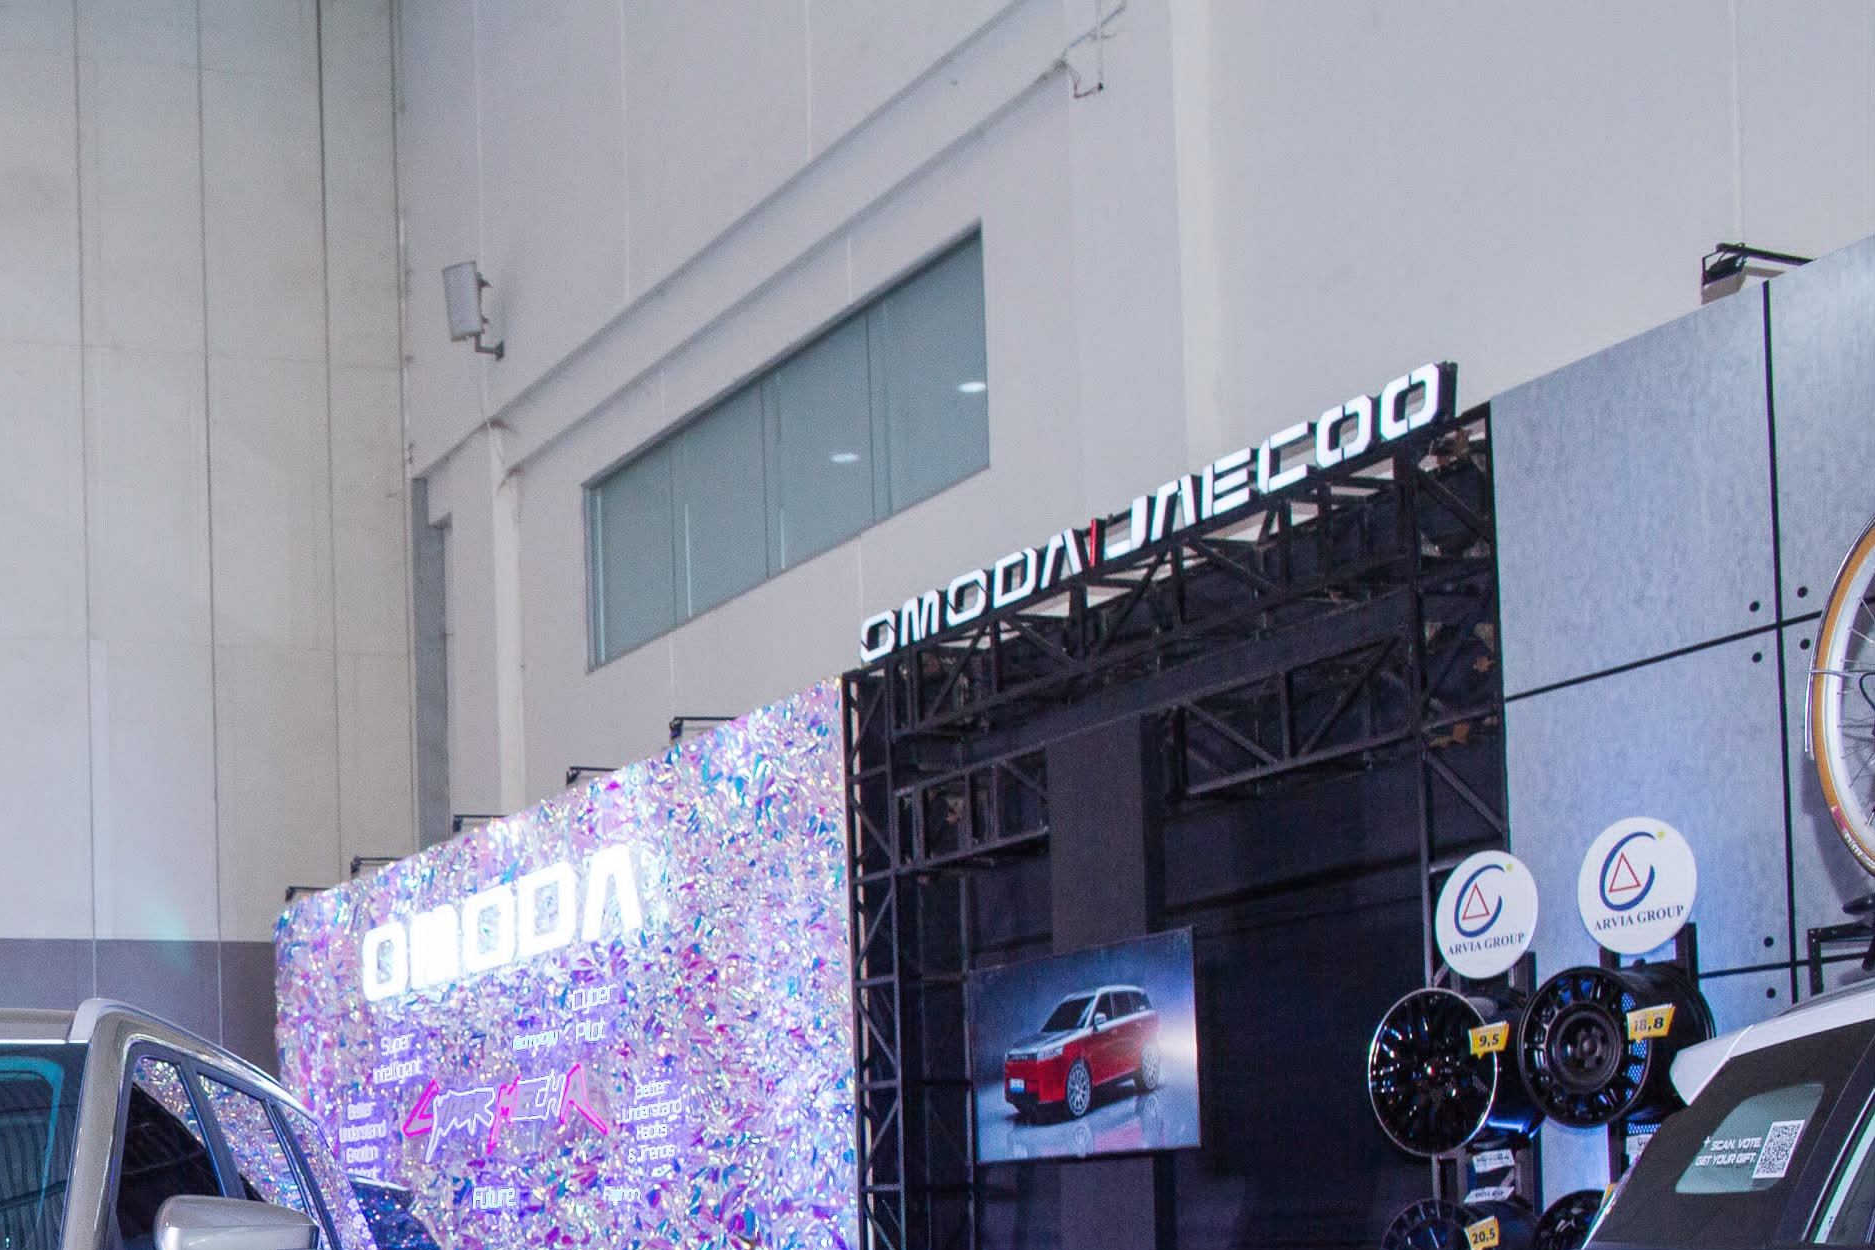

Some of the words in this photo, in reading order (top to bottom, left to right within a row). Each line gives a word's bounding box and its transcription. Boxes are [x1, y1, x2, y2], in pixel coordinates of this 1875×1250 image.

[860, 528, 1082, 663] OMODA
[1104, 362, 1440, 561] JAECOO
[361, 843, 643, 1002] OMODA
[1593, 915, 1633, 932] ARVIA
[1636, 904, 1685, 923] GROUP
[1446, 940, 1483, 956] ARVIA
[1484, 932, 1525, 949] GROUP
[575, 1016, 606, 1043] Pilot
[380, 1033, 416, 1059] Super
[372, 1055, 424, 1085] Intelligent
[635, 1080, 671, 1100] Better
[622, 1097, 682, 1123] Understand
[1695, 1155, 1713, 1167] GET
[1713, 1153, 1736, 1166] YOUR
[473, 1185, 517, 1210] Future
